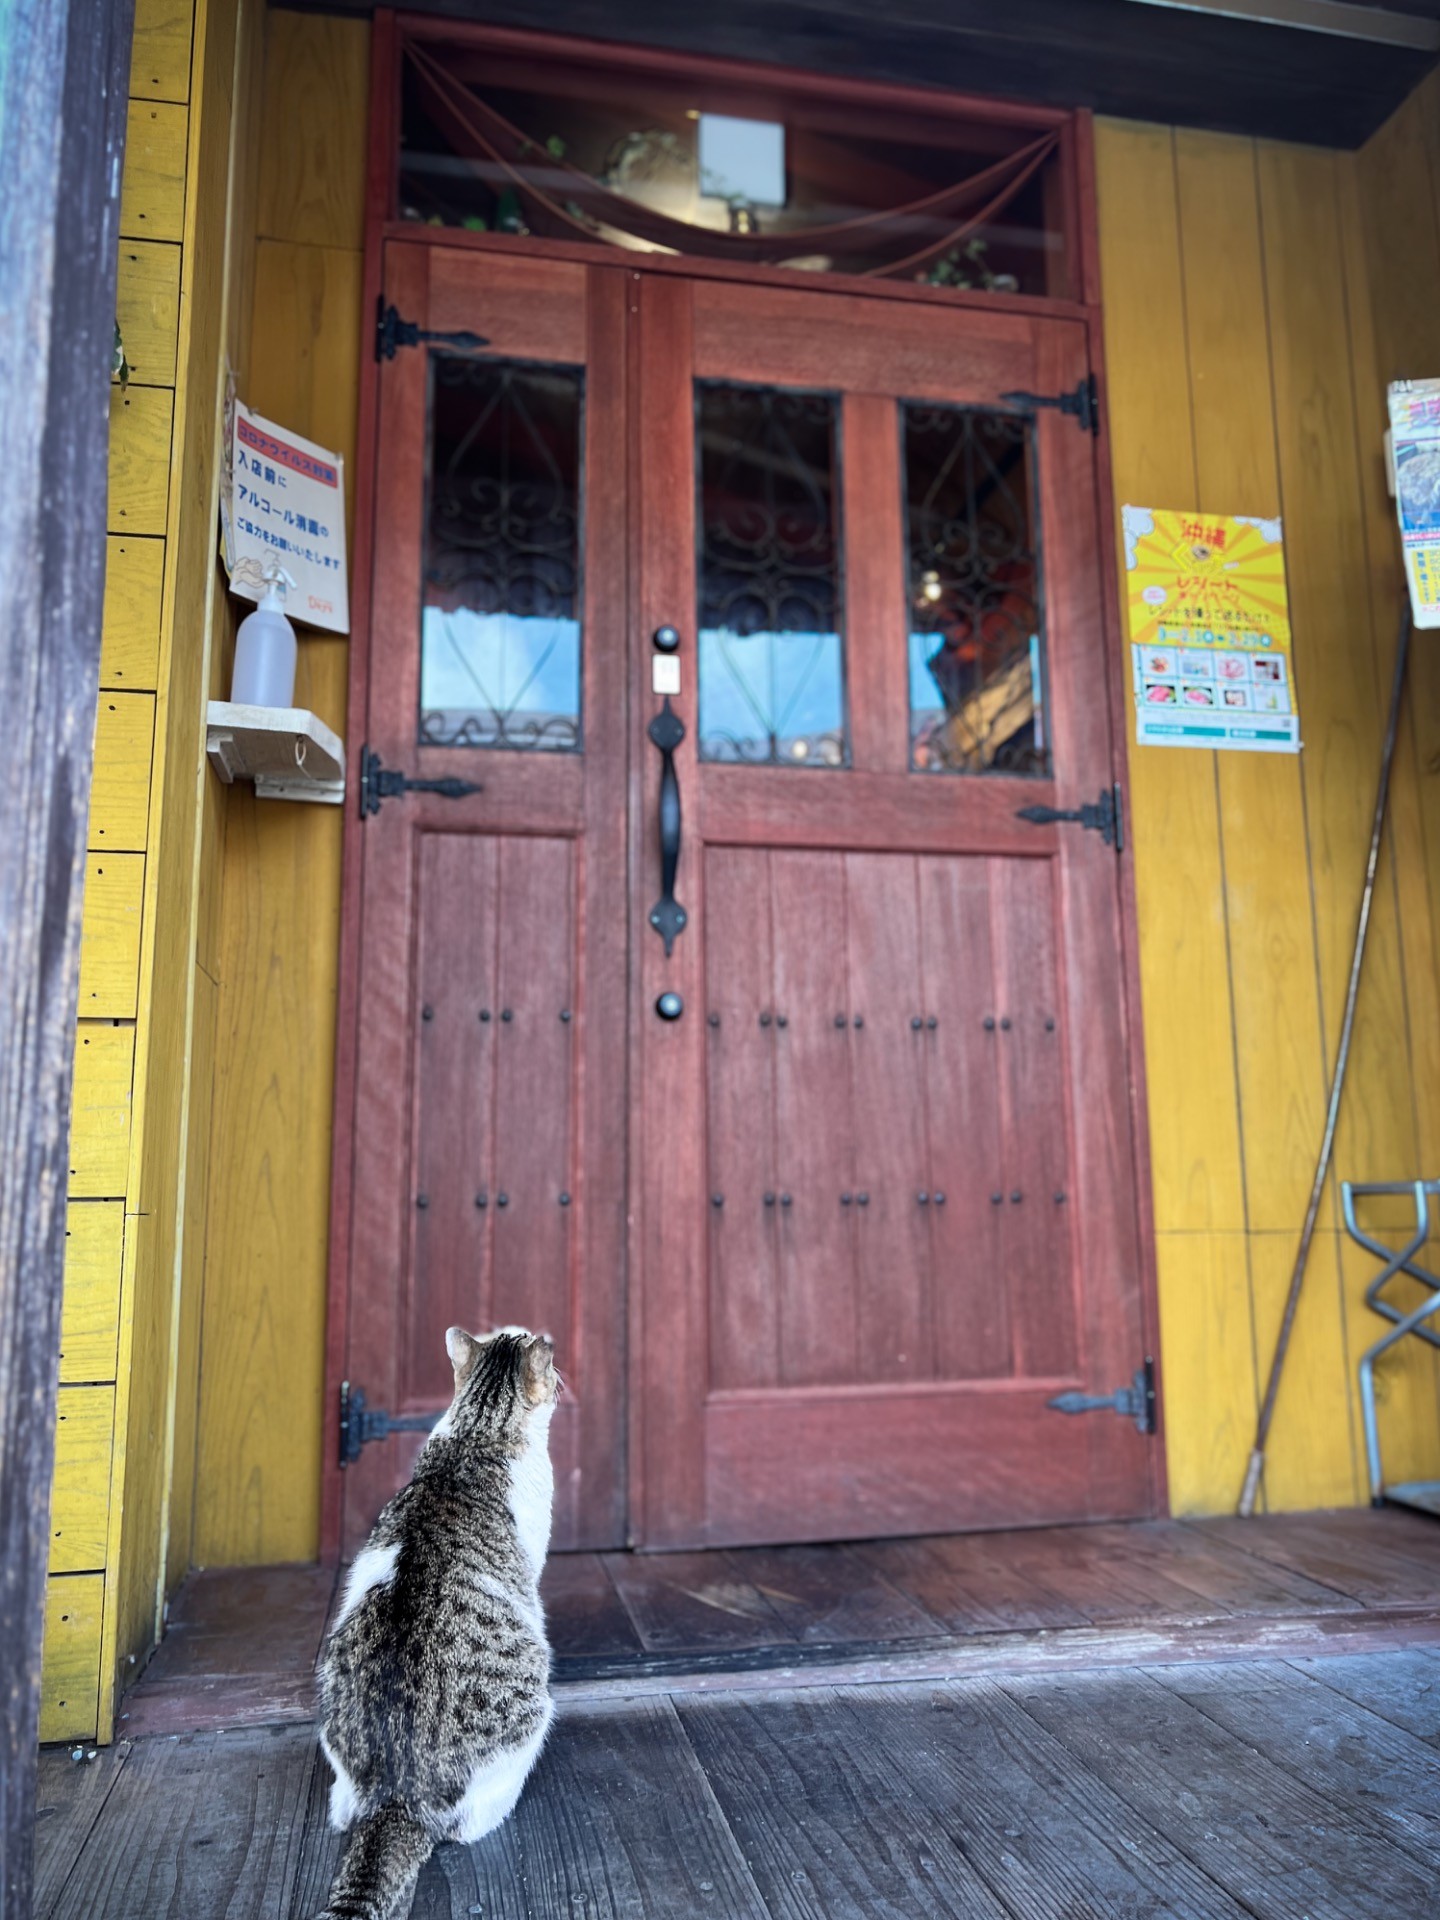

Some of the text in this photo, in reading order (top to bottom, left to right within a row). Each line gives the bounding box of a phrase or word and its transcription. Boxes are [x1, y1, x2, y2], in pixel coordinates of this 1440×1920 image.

[239, 449, 286, 488] 入店前に
[238, 484, 329, 537] アルコール消毒の
[237, 516, 339, 570] ご協力をお願いいたします
